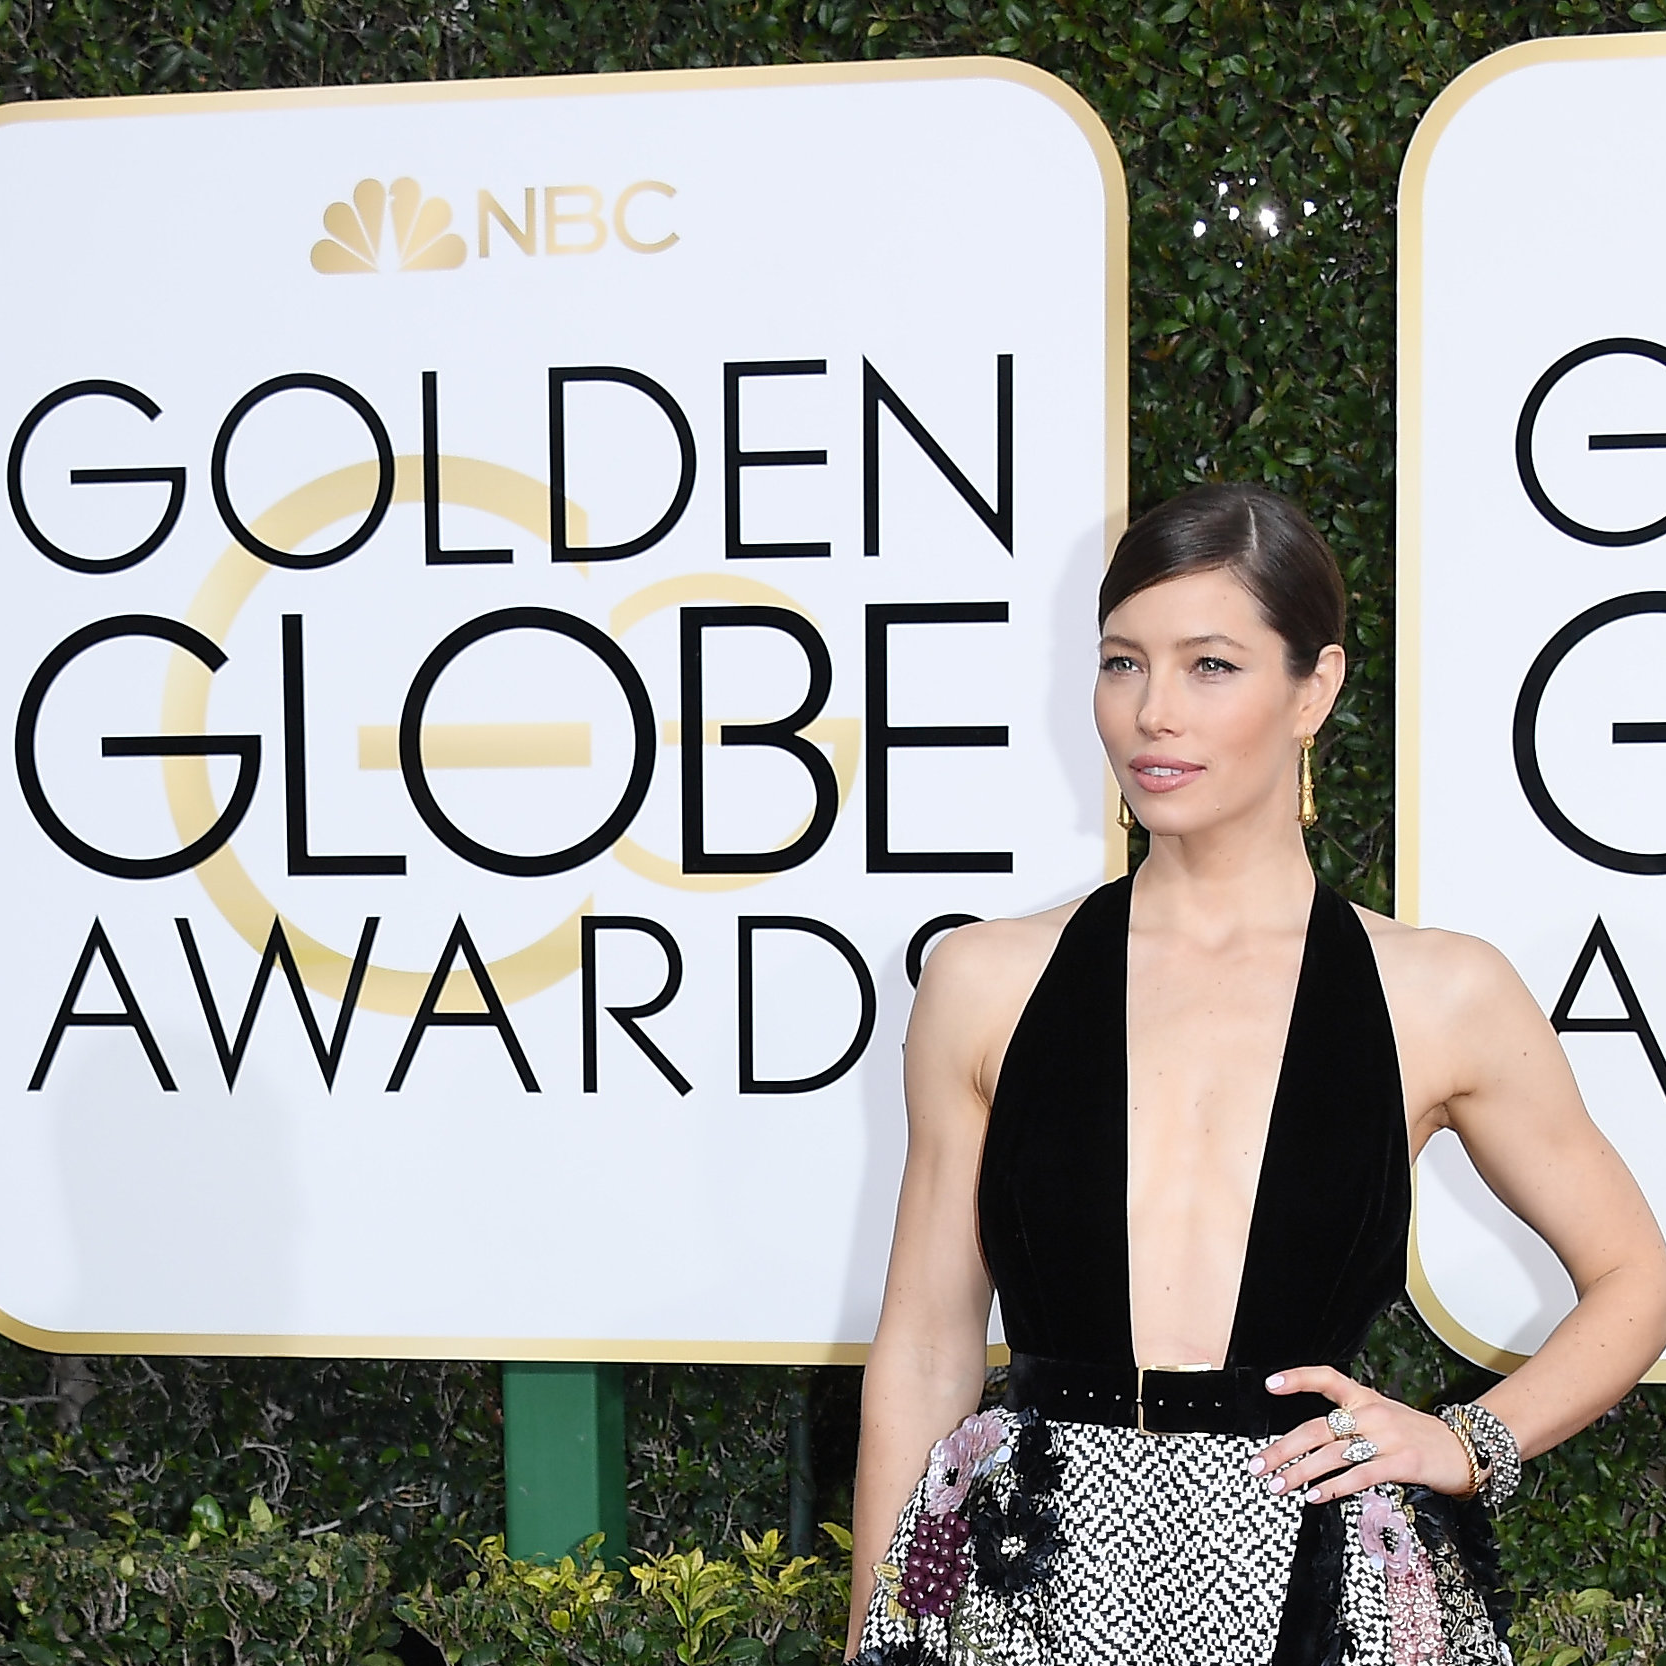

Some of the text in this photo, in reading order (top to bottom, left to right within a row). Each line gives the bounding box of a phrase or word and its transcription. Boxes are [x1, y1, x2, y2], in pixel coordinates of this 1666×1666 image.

[477, 180, 680, 259] NBC
[7, 354, 1013, 574] GOLDEN
[15, 602, 1013, 879] GLOBE
